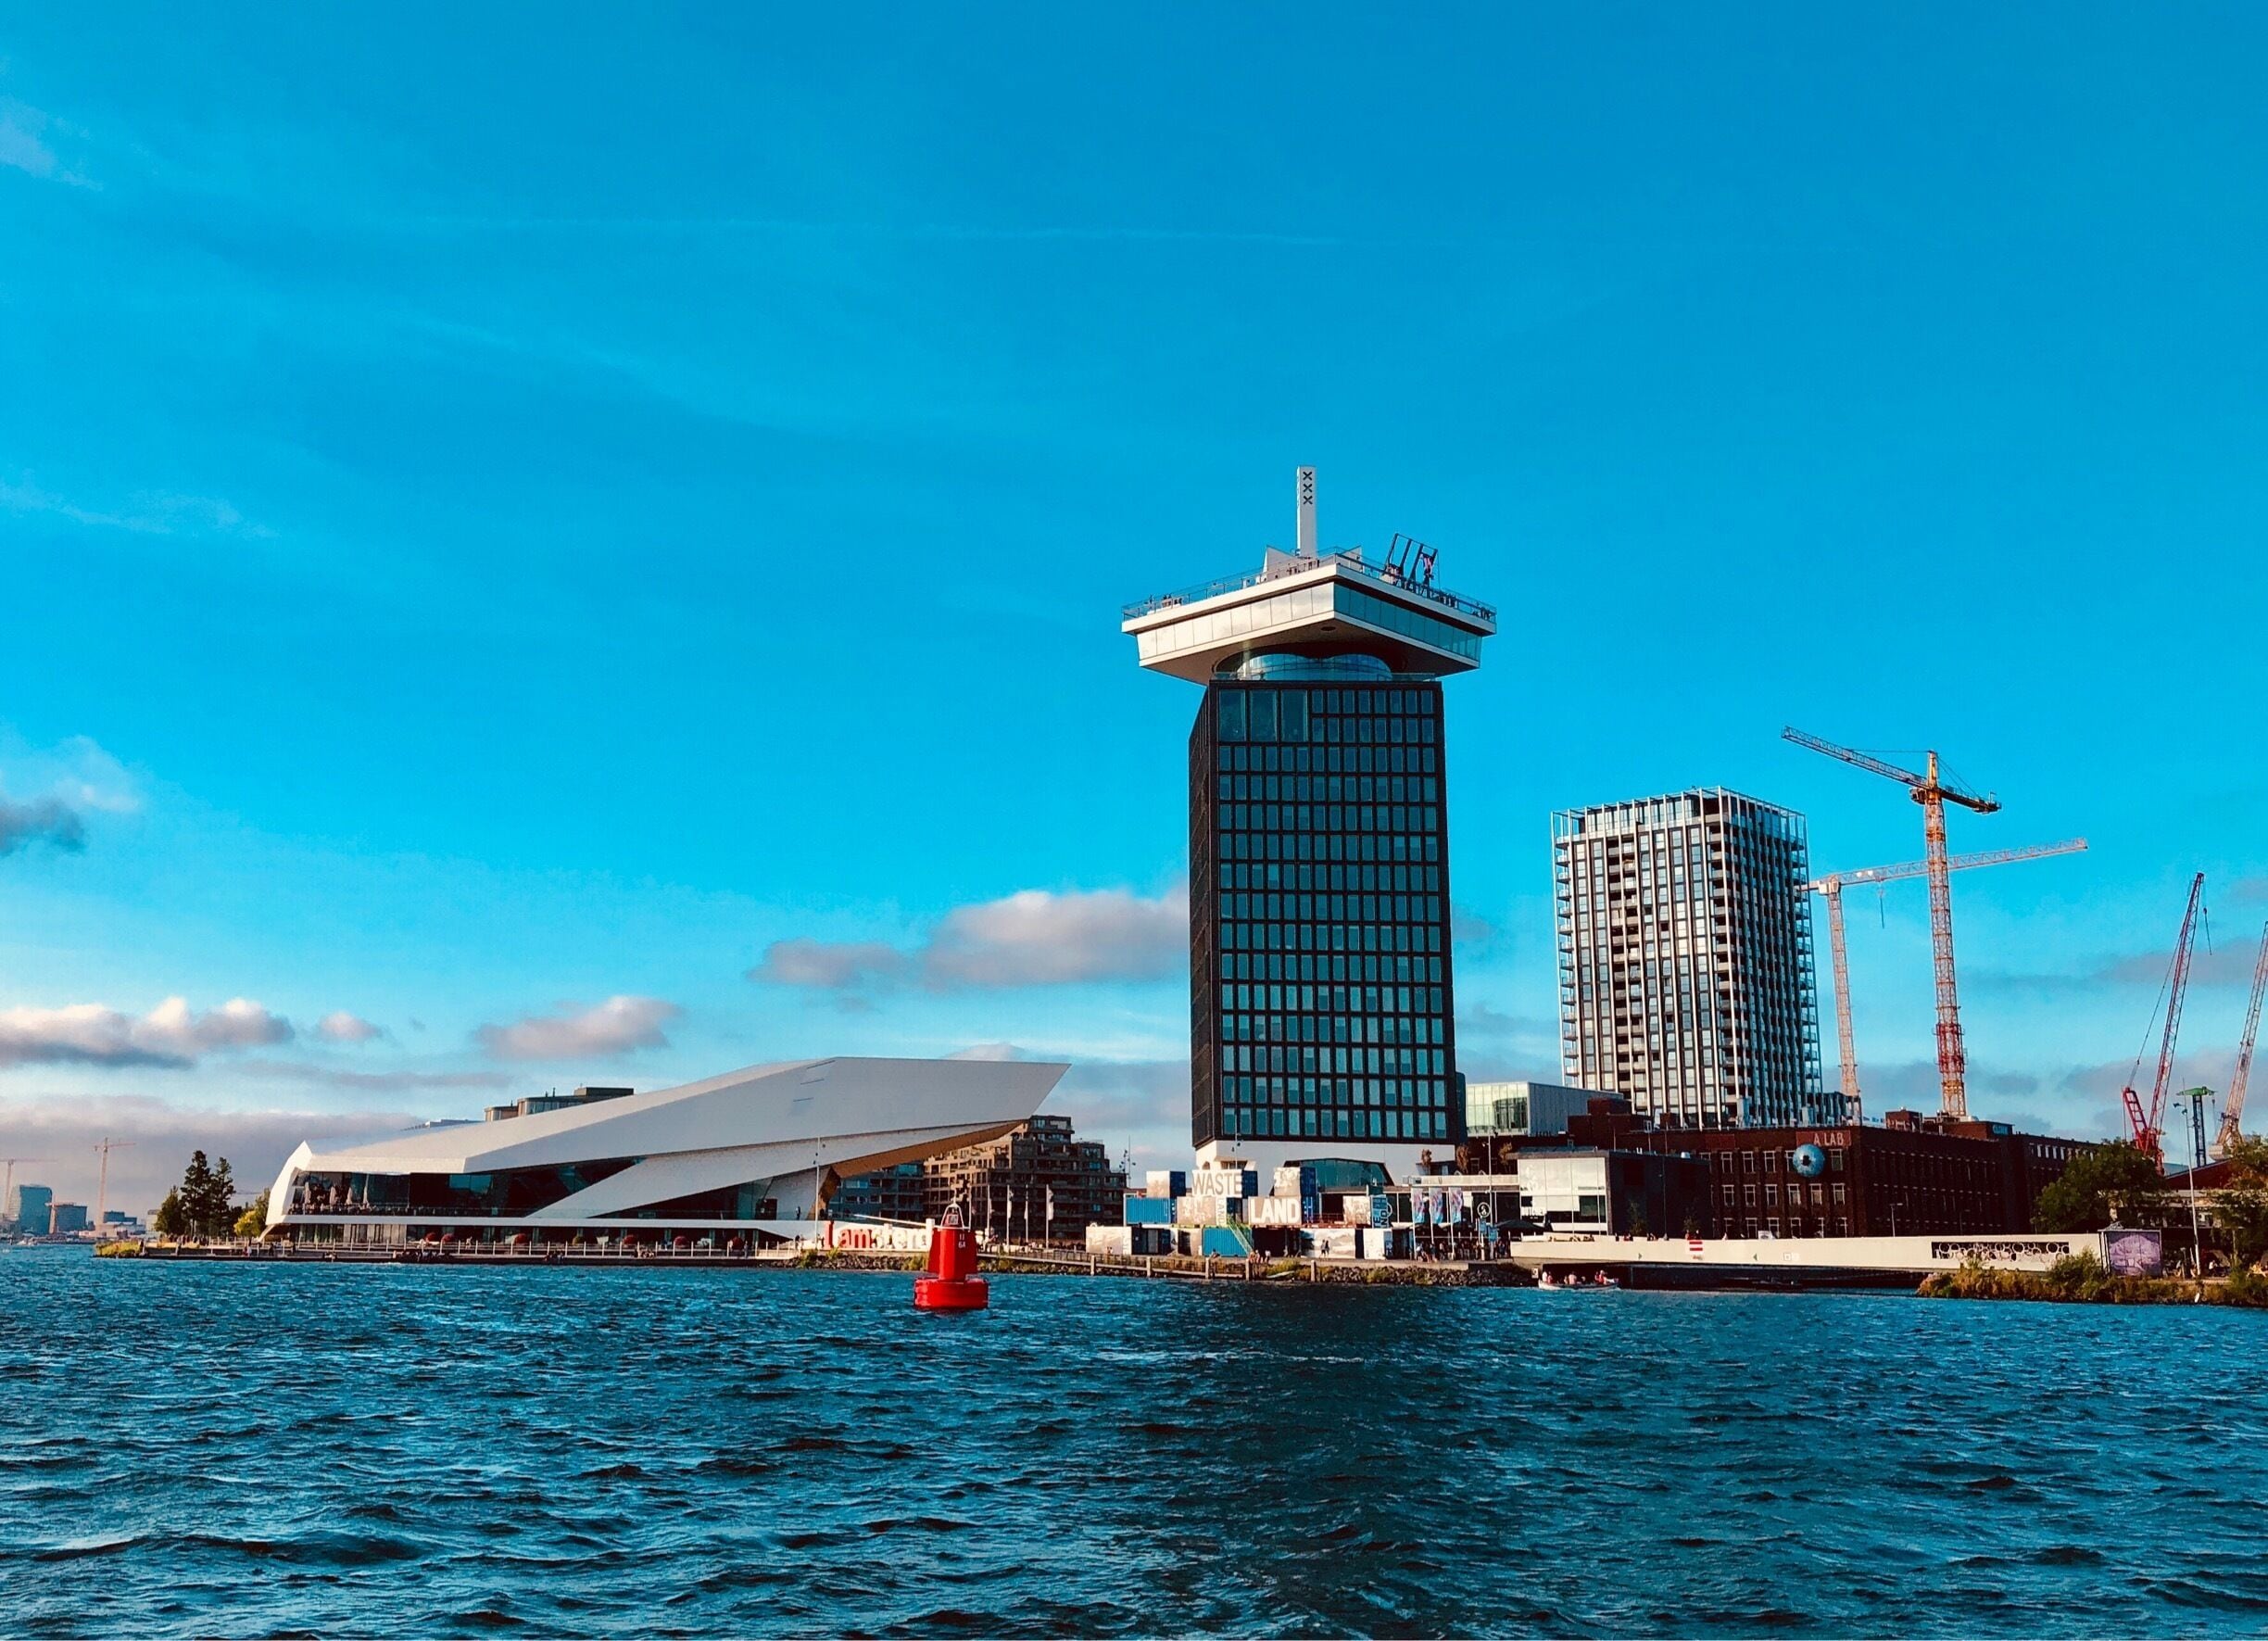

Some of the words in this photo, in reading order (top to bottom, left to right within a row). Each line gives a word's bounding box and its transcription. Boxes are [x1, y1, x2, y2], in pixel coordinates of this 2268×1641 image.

[1813, 1131, 1821, 1147] A
[1824, 1132, 1844, 1146] LAB
[1191, 1172, 1242, 1195] WASTE
[1250, 1198, 1301, 1224] LAND
[840, 1218, 935, 1250] amsterd
